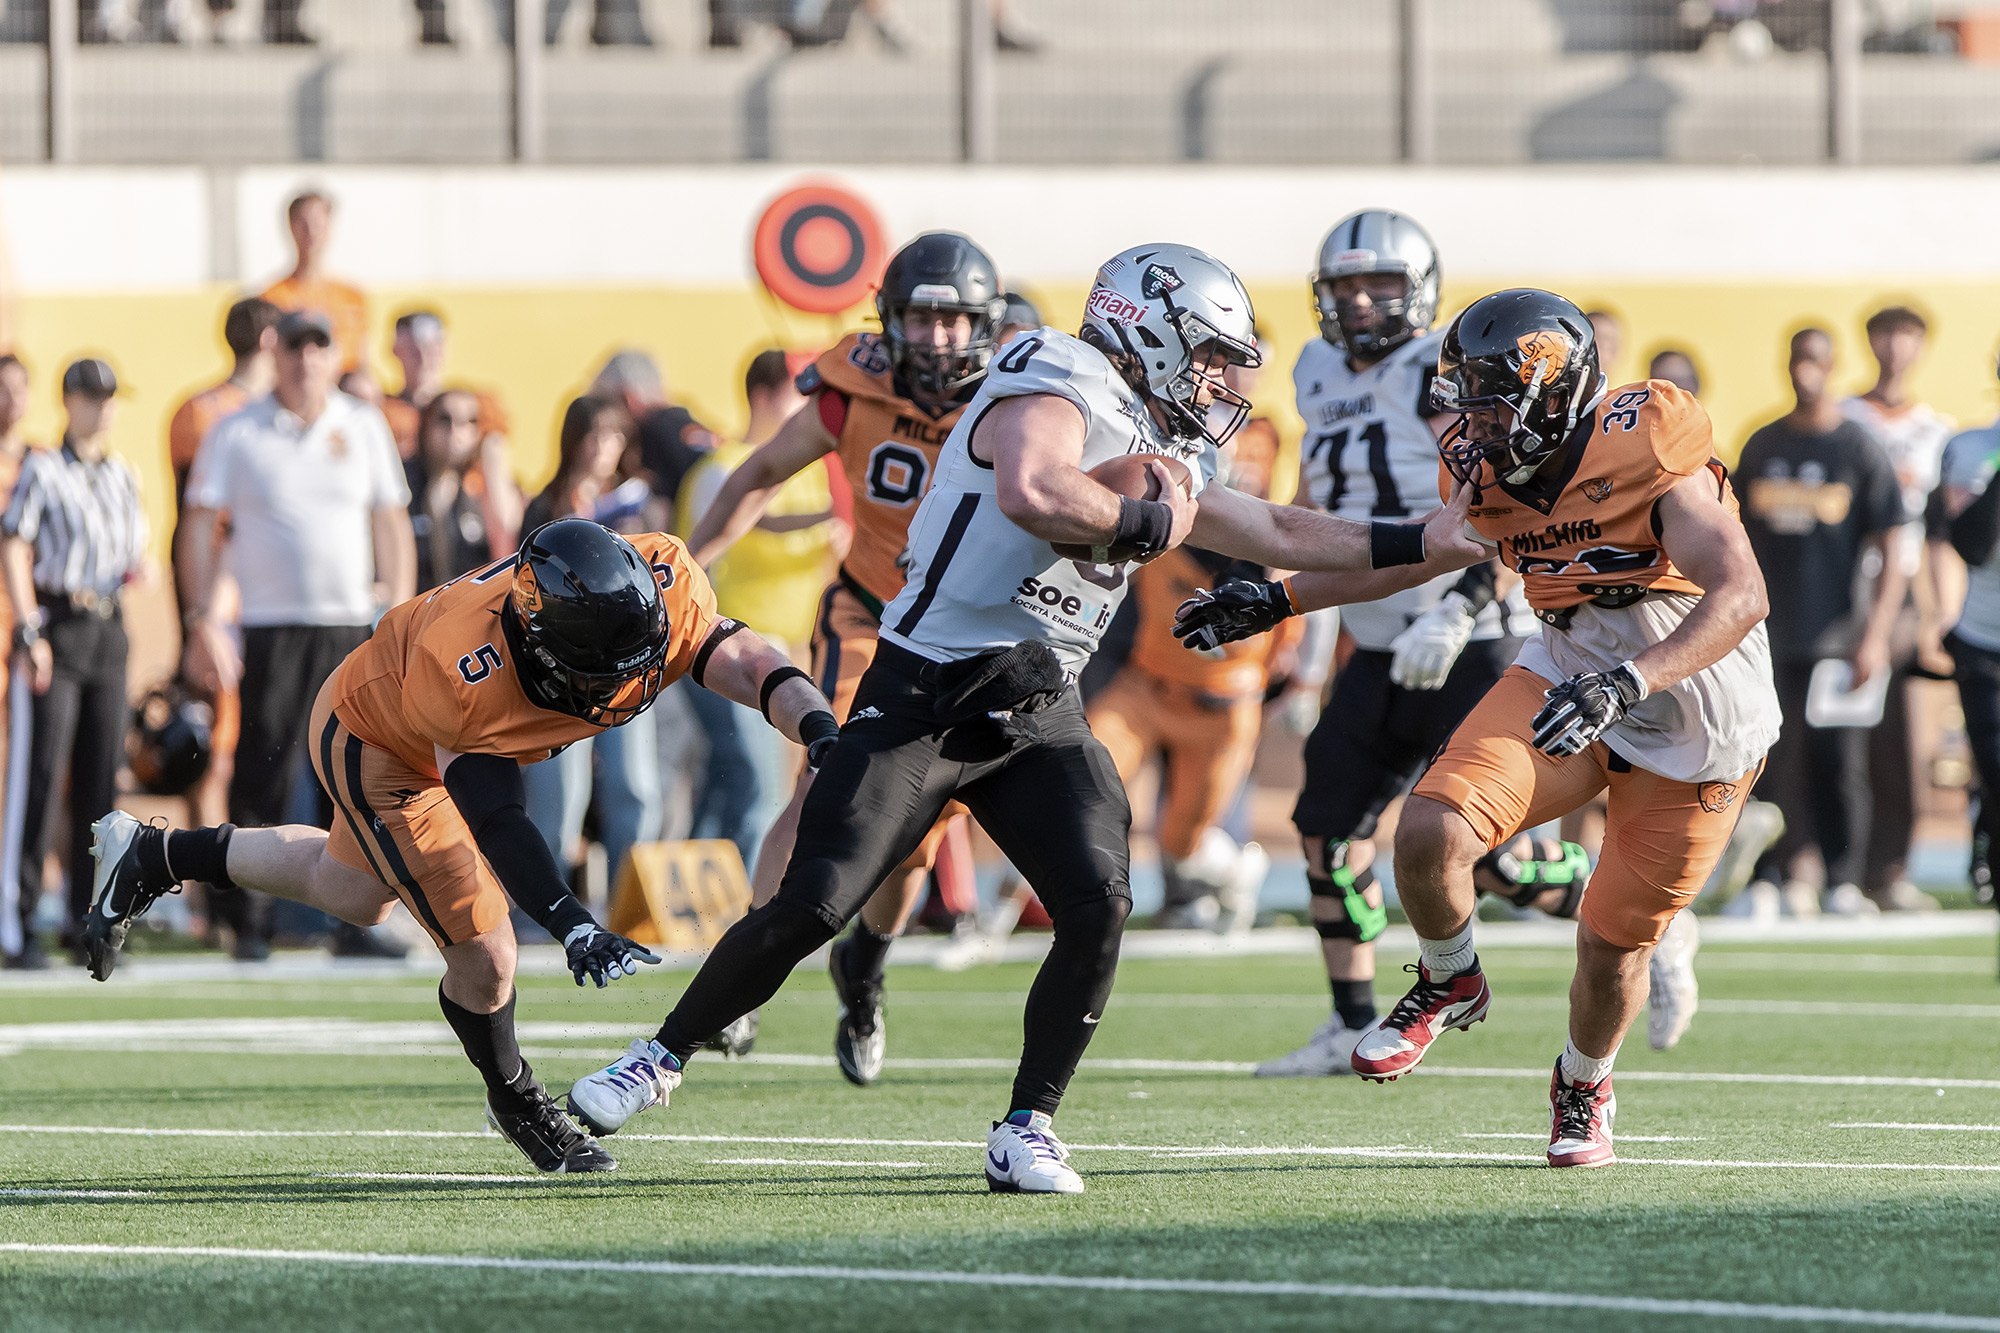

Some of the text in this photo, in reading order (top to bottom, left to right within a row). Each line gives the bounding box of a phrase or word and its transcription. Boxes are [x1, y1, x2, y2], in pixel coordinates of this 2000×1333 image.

[1150, 266, 1180, 286] FROGS
[1089, 291, 1149, 323] eriani
[998, 337, 1044, 373] 0
[1602, 386, 1651, 436] 39
[1310, 419, 1410, 516] 71
[1504, 518, 1602, 554] MILANO
[1009, 596, 1049, 618] SOCIETÀ
[1017, 577, 1110, 630] soevis
[457, 643, 503, 685] 5
[617, 650, 651, 671] Riddell
